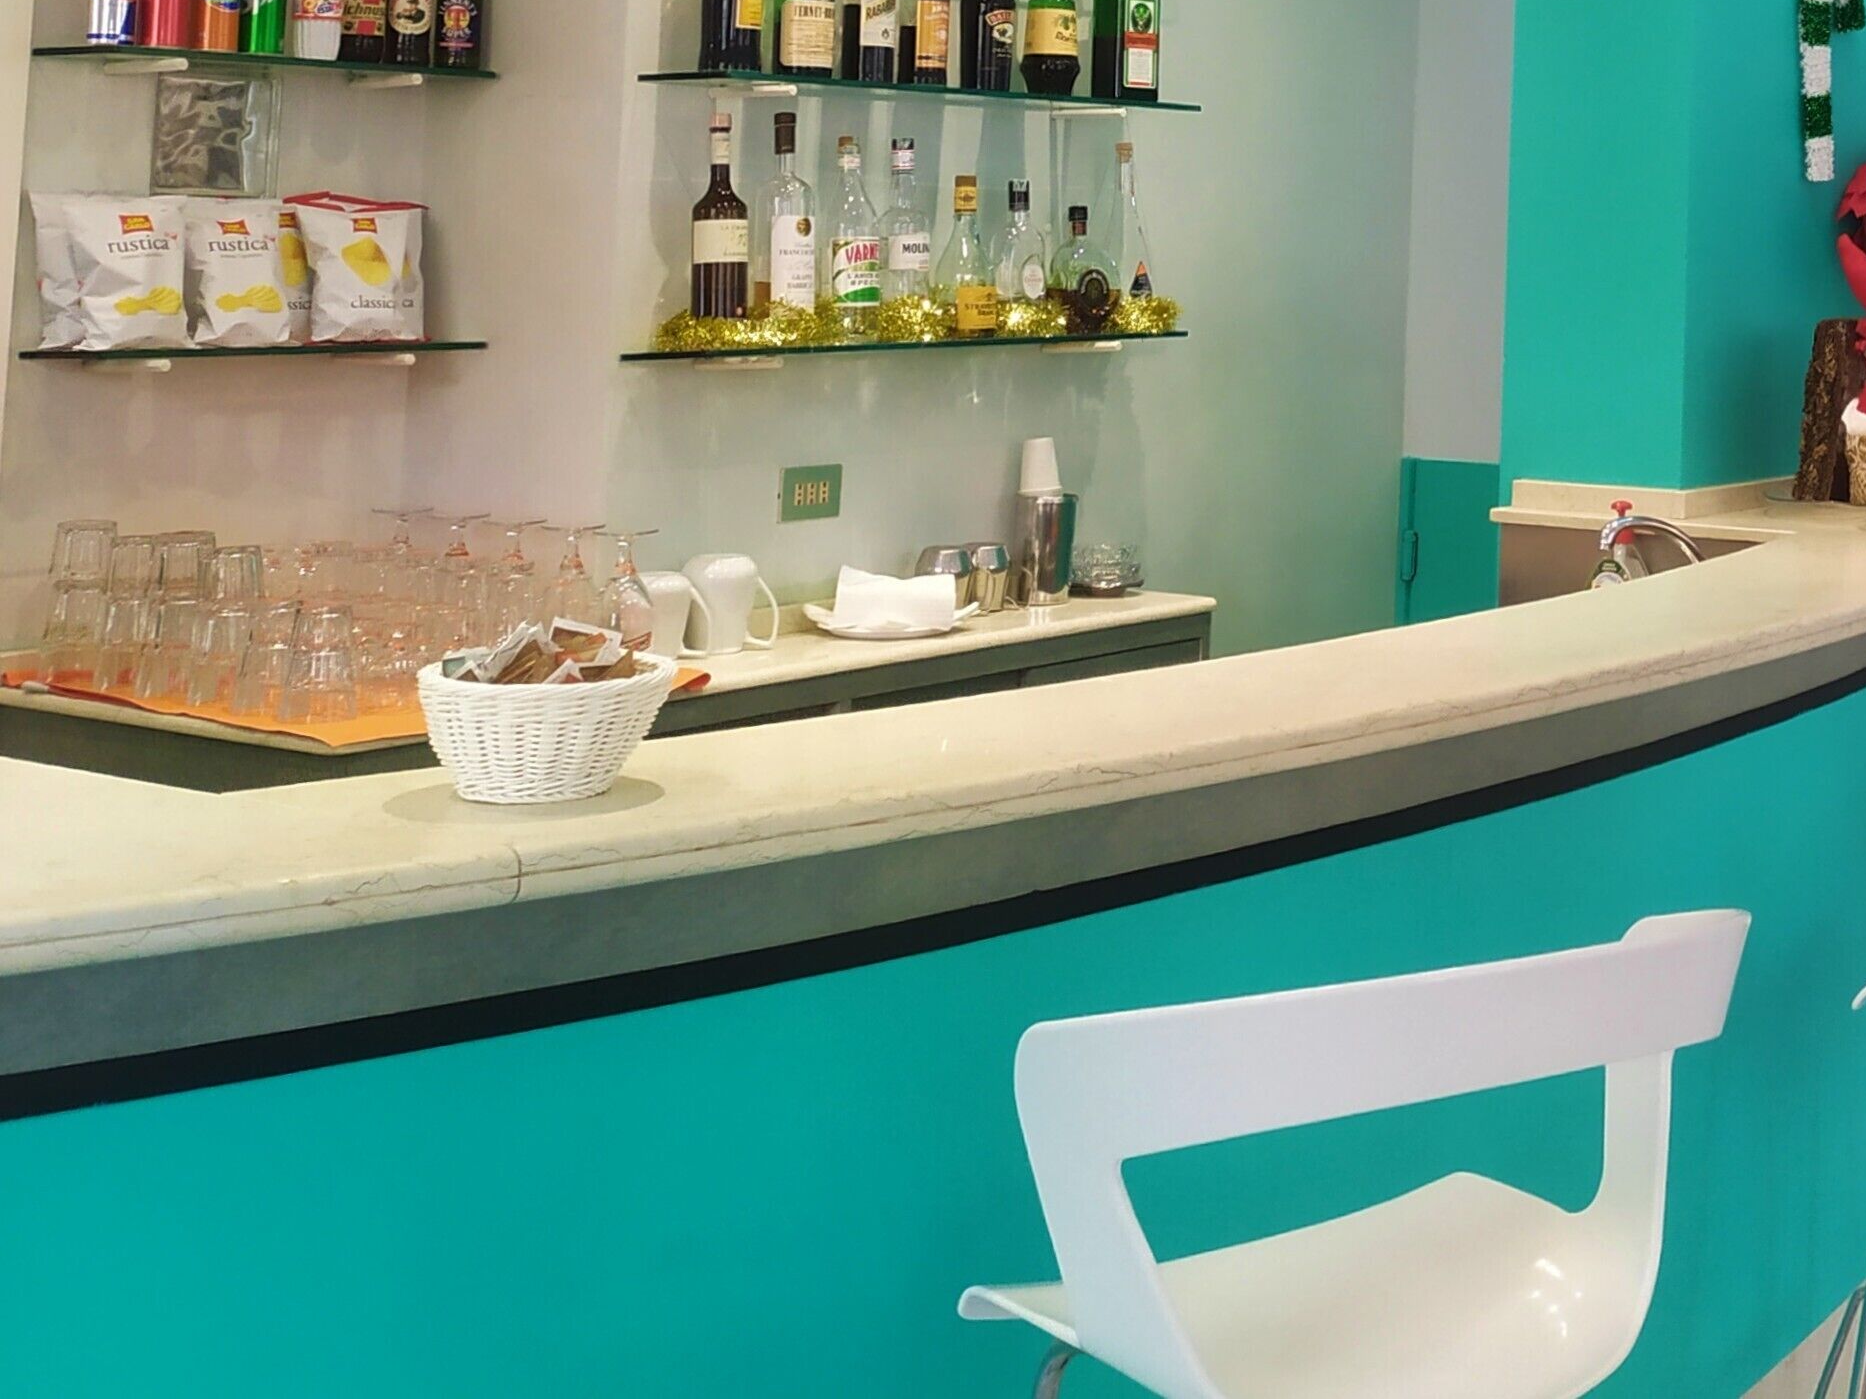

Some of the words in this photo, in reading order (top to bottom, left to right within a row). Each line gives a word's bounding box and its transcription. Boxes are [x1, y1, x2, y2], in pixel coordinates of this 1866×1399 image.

[107, 234, 170, 253] rustica
[208, 236, 269, 252] rustica
[902, 243, 930, 253] MOLIN
[350, 294, 397, 309] classic
